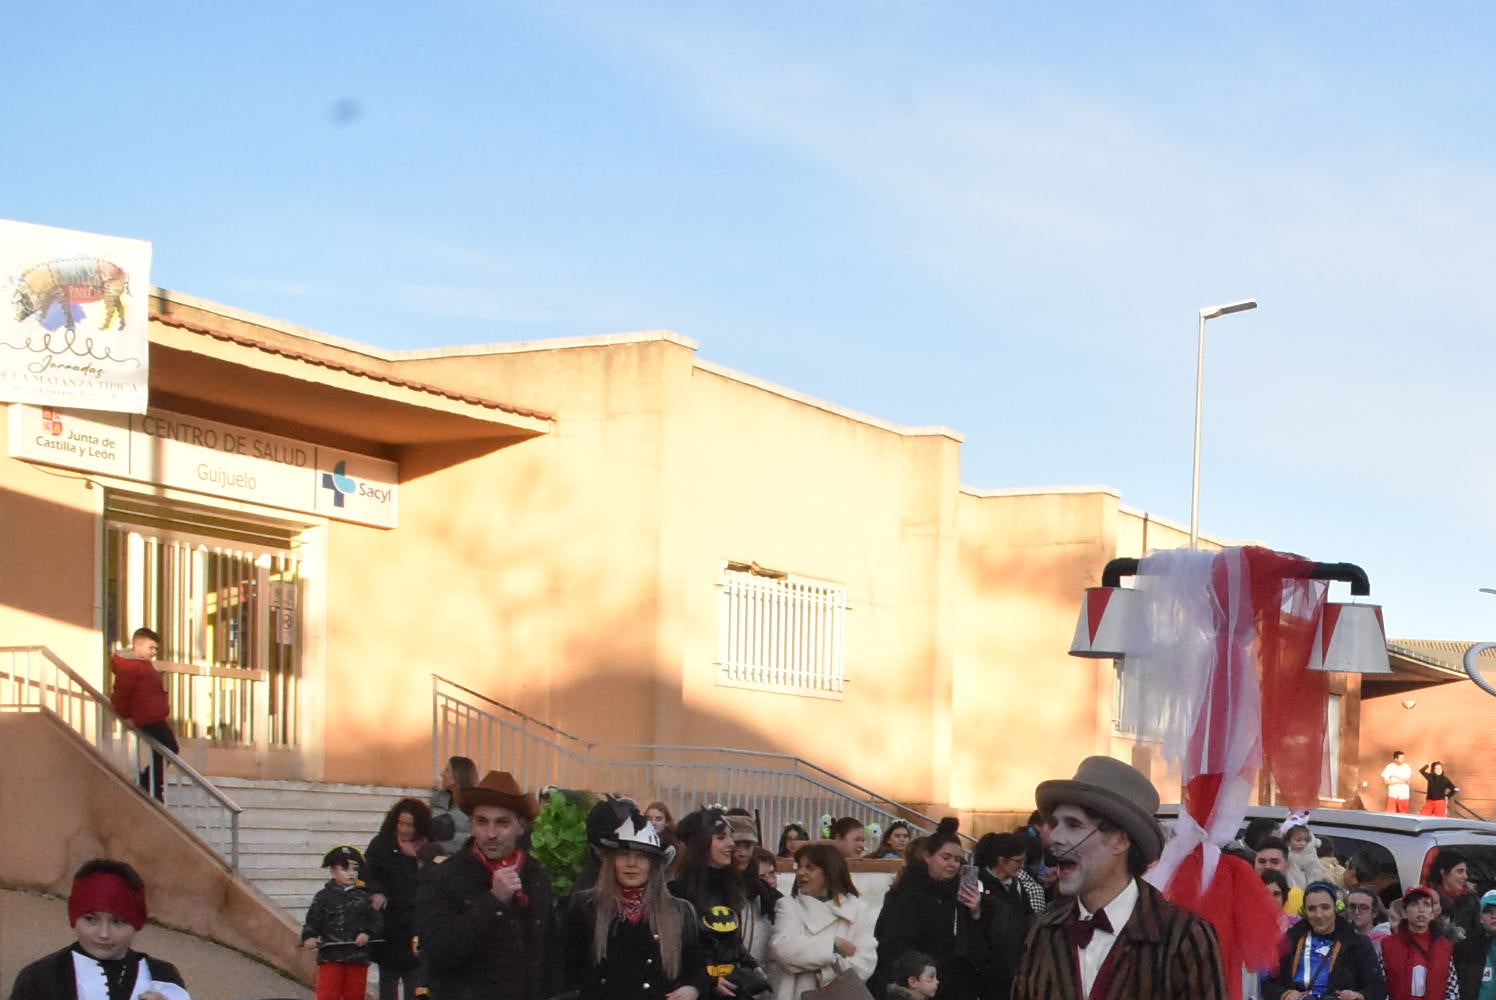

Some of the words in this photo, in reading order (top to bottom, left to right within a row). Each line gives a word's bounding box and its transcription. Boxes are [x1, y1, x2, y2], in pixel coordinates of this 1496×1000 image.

[27, 354, 105, 378] Jornadas
[32, 374, 94, 388] MATANZA
[35, 435, 76, 453] Castilla
[79, 446, 86, 457] y
[88, 446, 115, 460] León
[67, 430, 99, 445] Junta
[102, 437, 116, 449] de
[142, 415, 218, 449] CENTRO
[224, 433, 247, 455] DE
[253, 439, 307, 467] SALUD
[197, 463, 257, 490] Guijuelo
[359, 482, 392, 503] Sacyl
